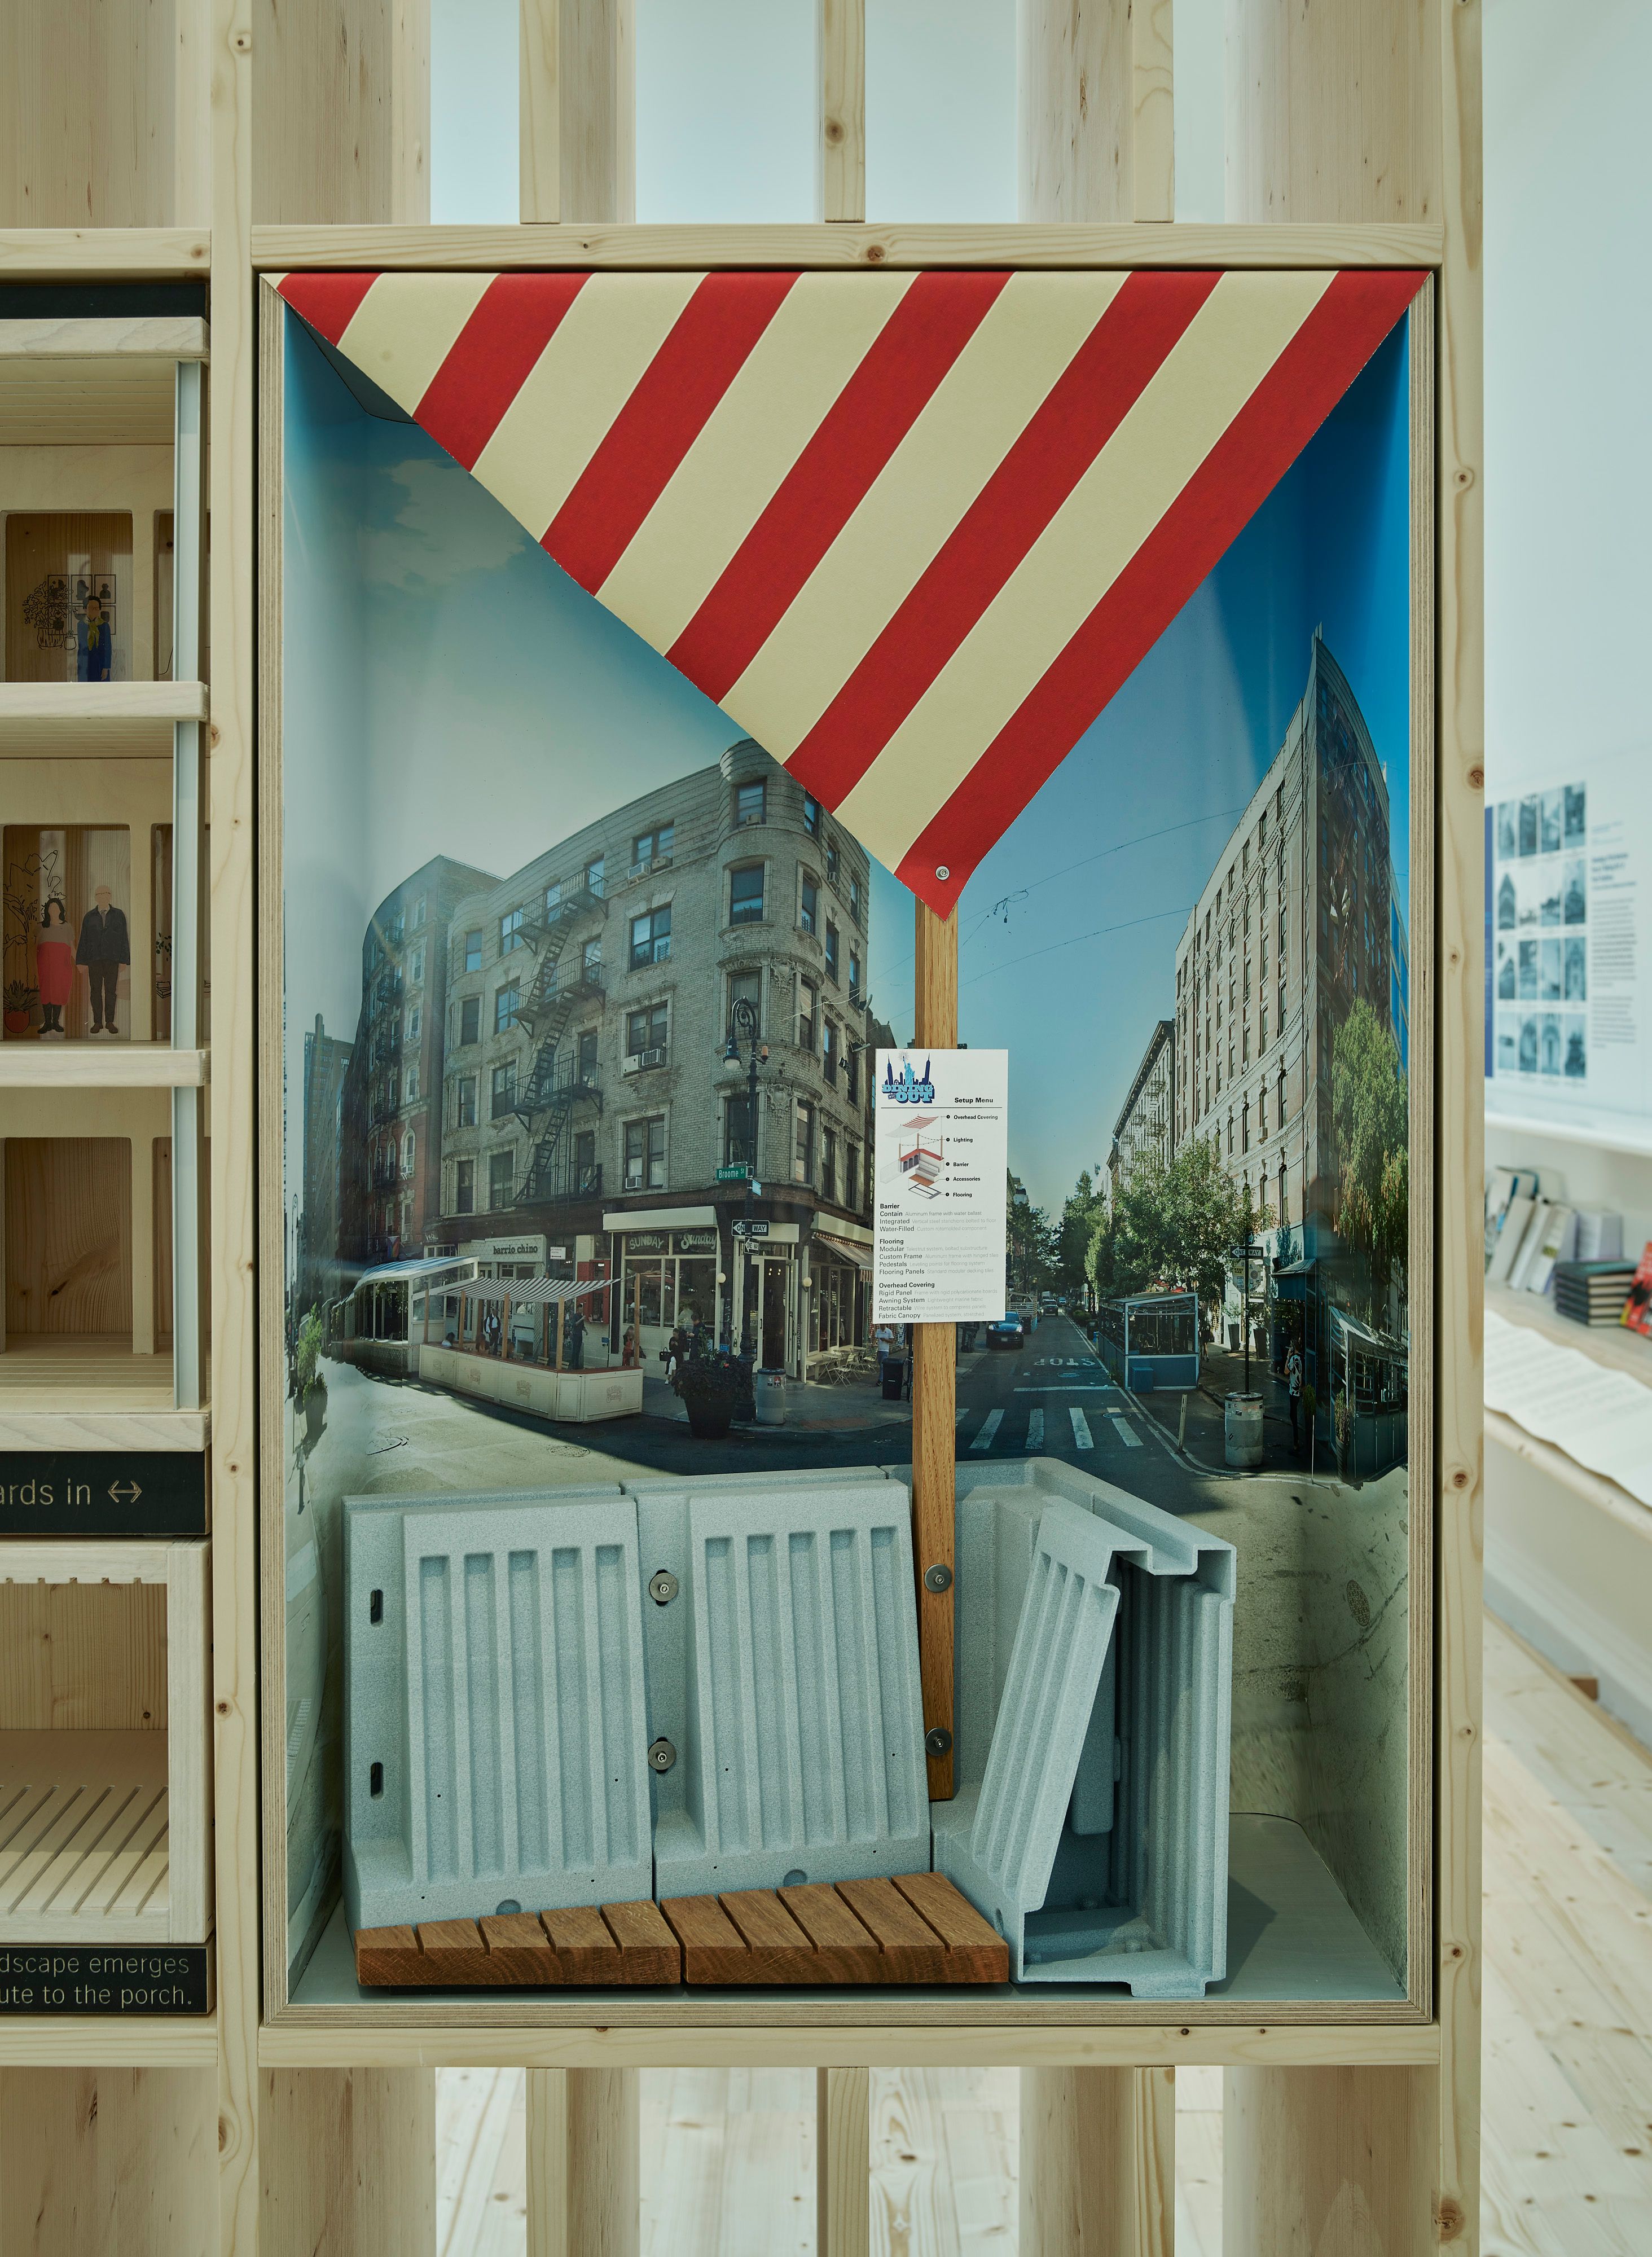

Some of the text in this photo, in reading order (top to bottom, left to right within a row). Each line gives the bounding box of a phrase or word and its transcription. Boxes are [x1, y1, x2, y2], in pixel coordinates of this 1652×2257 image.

[882, 1084, 934, 1093] DINING
[895, 1091, 934, 1103] OUT
[719, 1170, 739, 1178] Broome
[630, 1235, 664, 1250] SUNDAY
[681, 1233, 716, 1250] Sunday
[493, 1244, 538, 1254] barrio chino
[68, 1478, 90, 1505] in
[0, 1953, 189, 1978] dscape emerges
[42, 1986, 64, 2004] to
[74, 1984, 111, 2004] the
[121, 1985, 192, 2009] porch.
